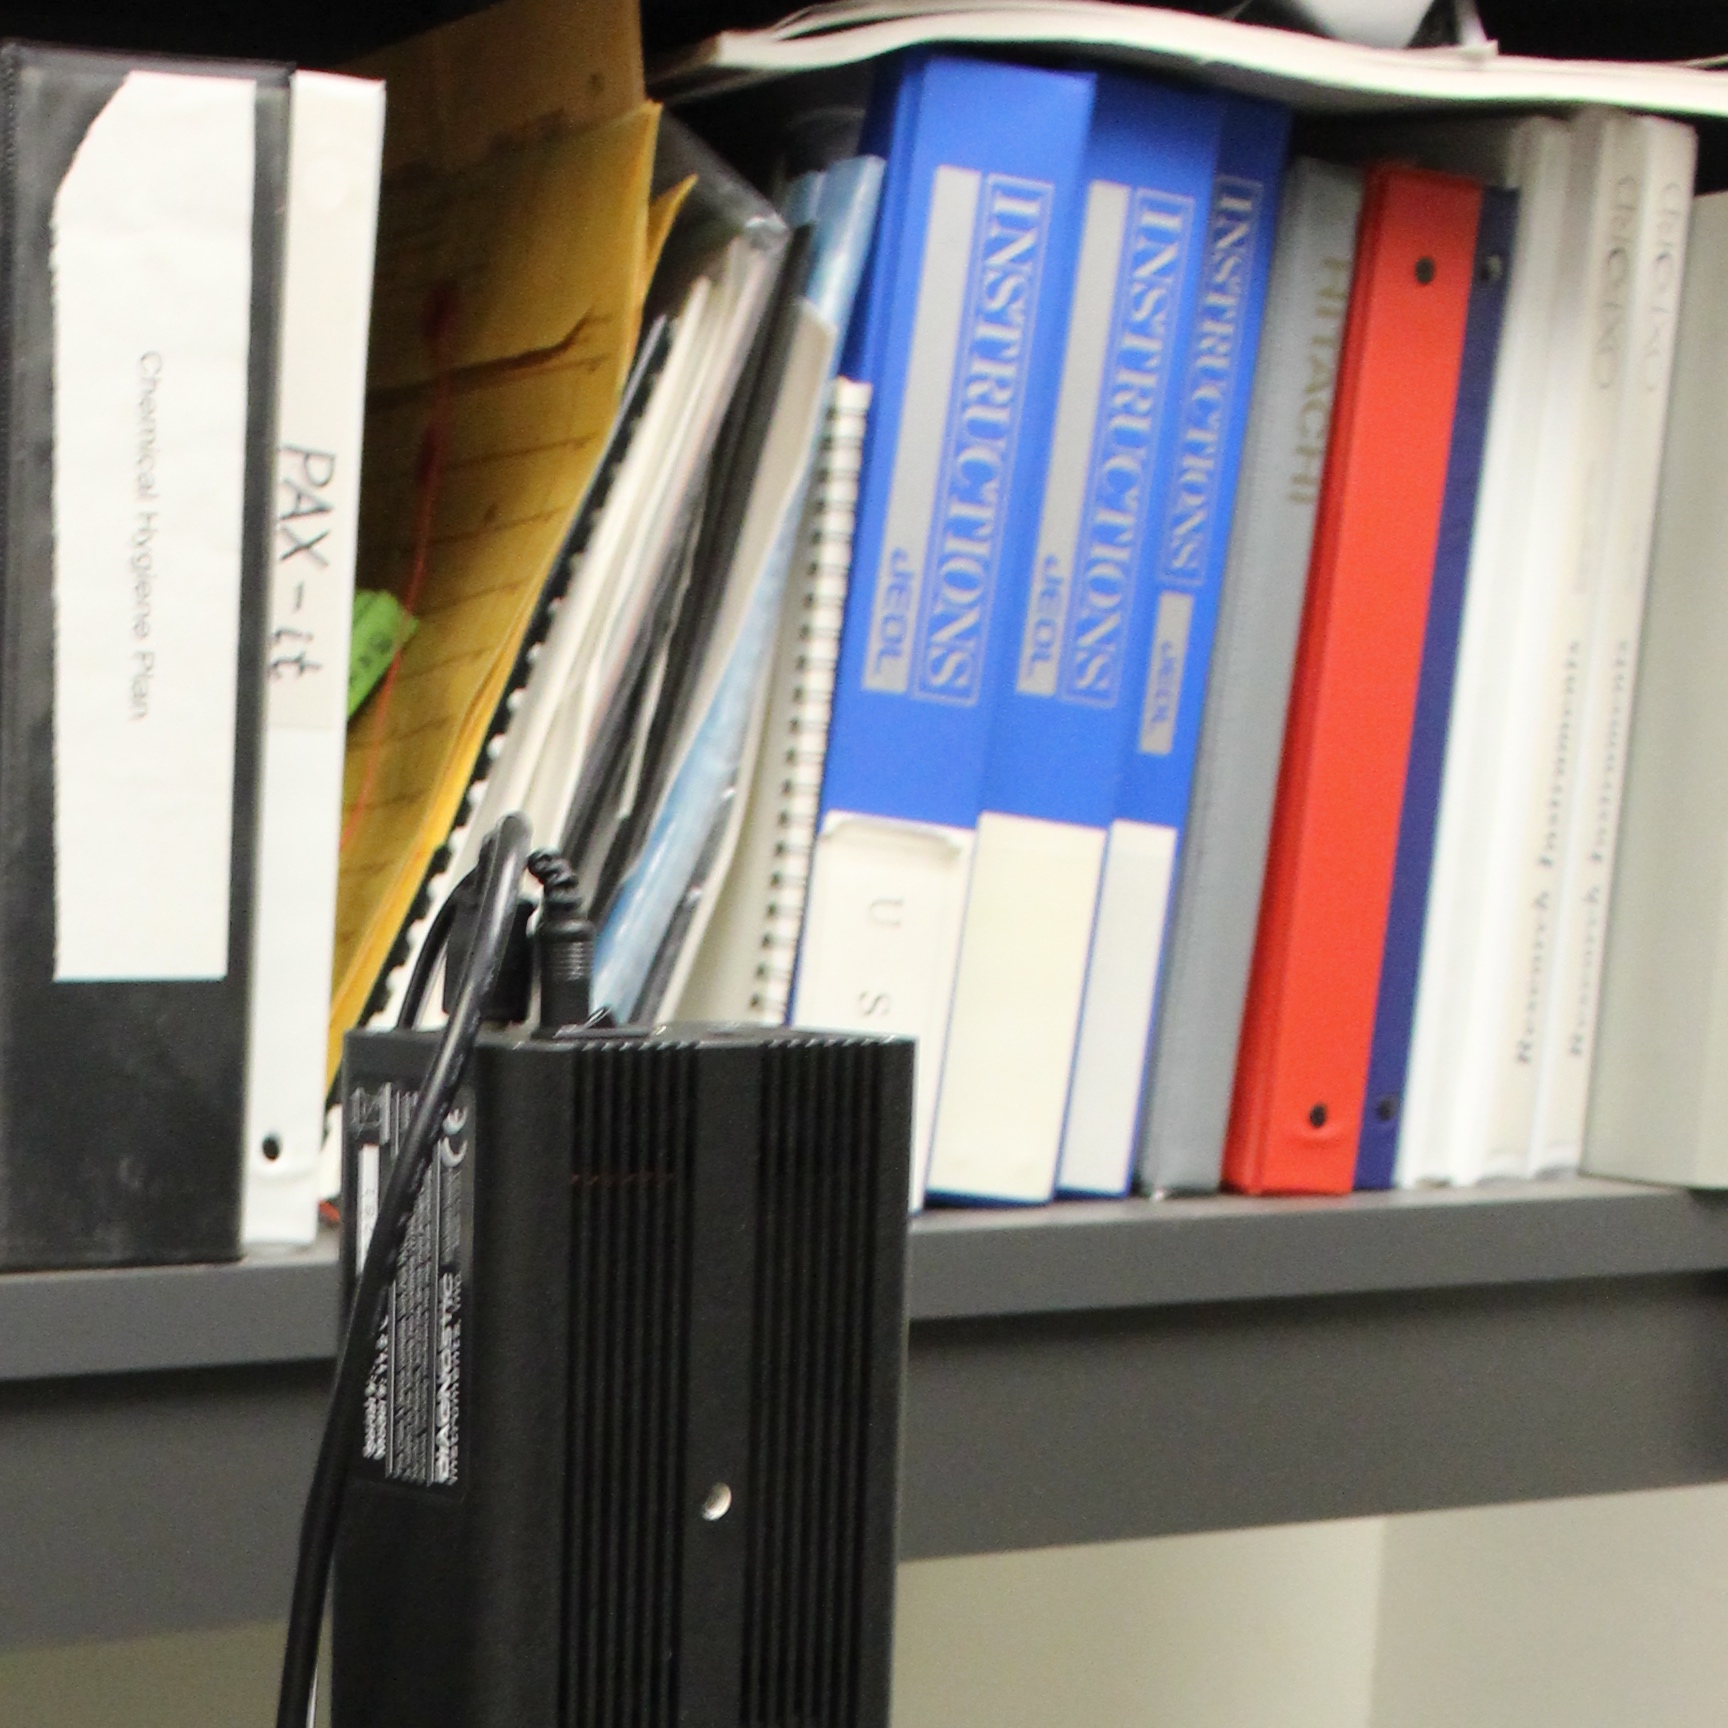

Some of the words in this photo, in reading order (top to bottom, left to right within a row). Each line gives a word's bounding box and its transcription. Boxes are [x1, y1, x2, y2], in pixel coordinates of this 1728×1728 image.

[134, 350, 163, 505] Chemical
[925, 184, 1044, 690] INSTRUCTIONS
[1072, 202, 1185, 694] INSTRUCTIONS
[1169, 183, 1254, 573] INSTRUCTIONS
[1286, 255, 1352, 510] HITACHI
[130, 511, 160, 645] Hygiene
[266, 442, 338, 686] PAX-it
[874, 550, 914, 670] JEOL
[1031, 554, 1067, 670] JEOL
[127, 652, 154, 723] Plan
[1148, 642, 1180, 732] JEOL
[865, 896, 905, 931] U
[1512, 889, 1553, 1068] Research
[1534, 638, 1581, 871] Instruments
[1567, 884, 1602, 1060] Research
[1587, 638, 1631, 866] Instruments
[856, 988, 894, 1020] S
